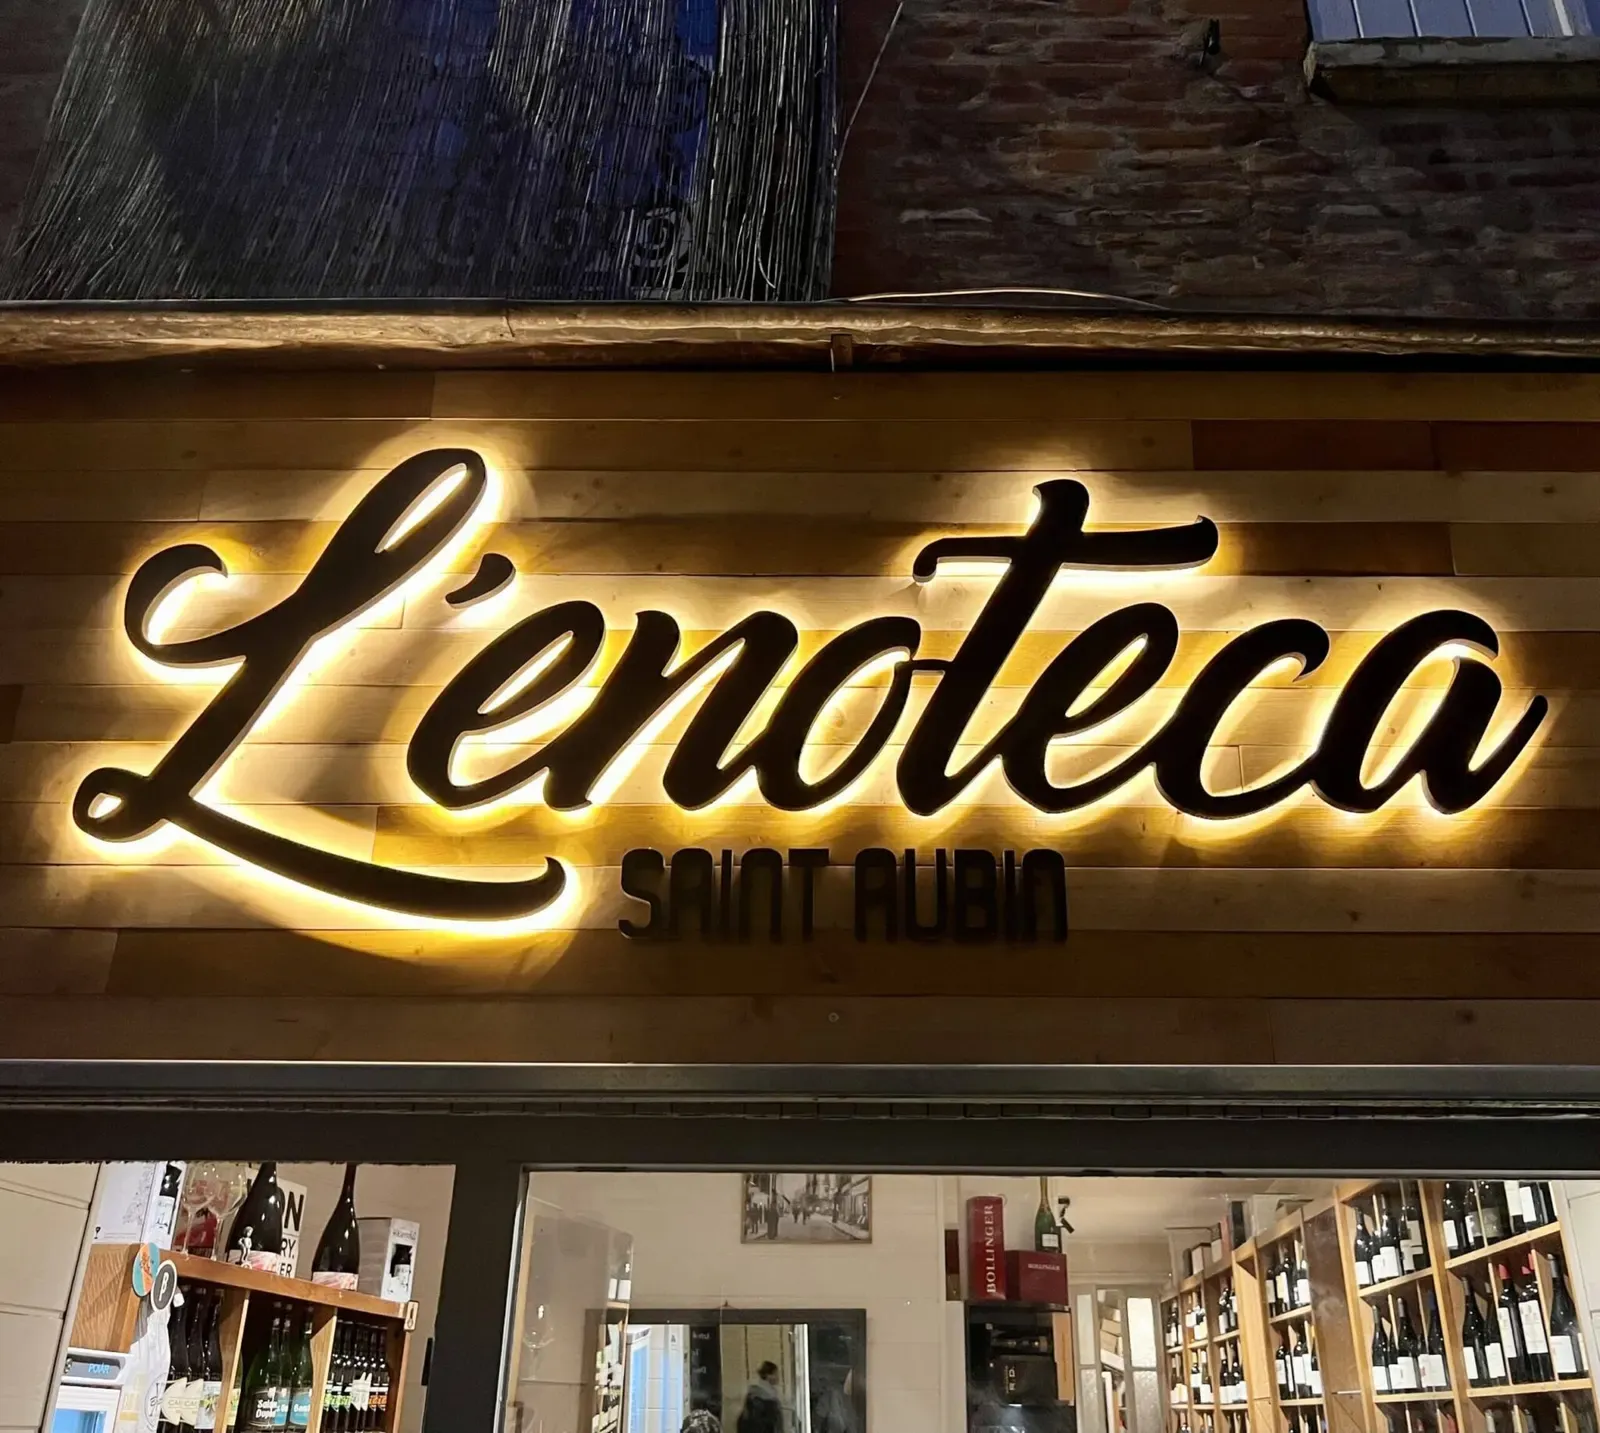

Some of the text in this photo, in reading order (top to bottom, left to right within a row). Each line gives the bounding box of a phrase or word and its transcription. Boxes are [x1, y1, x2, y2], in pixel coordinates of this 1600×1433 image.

[73, 446, 1549, 922] L'enoteca
[618, 847, 1067, 942] SAINT AUBIN
[984, 1204, 997, 1293] BOLLINGER
